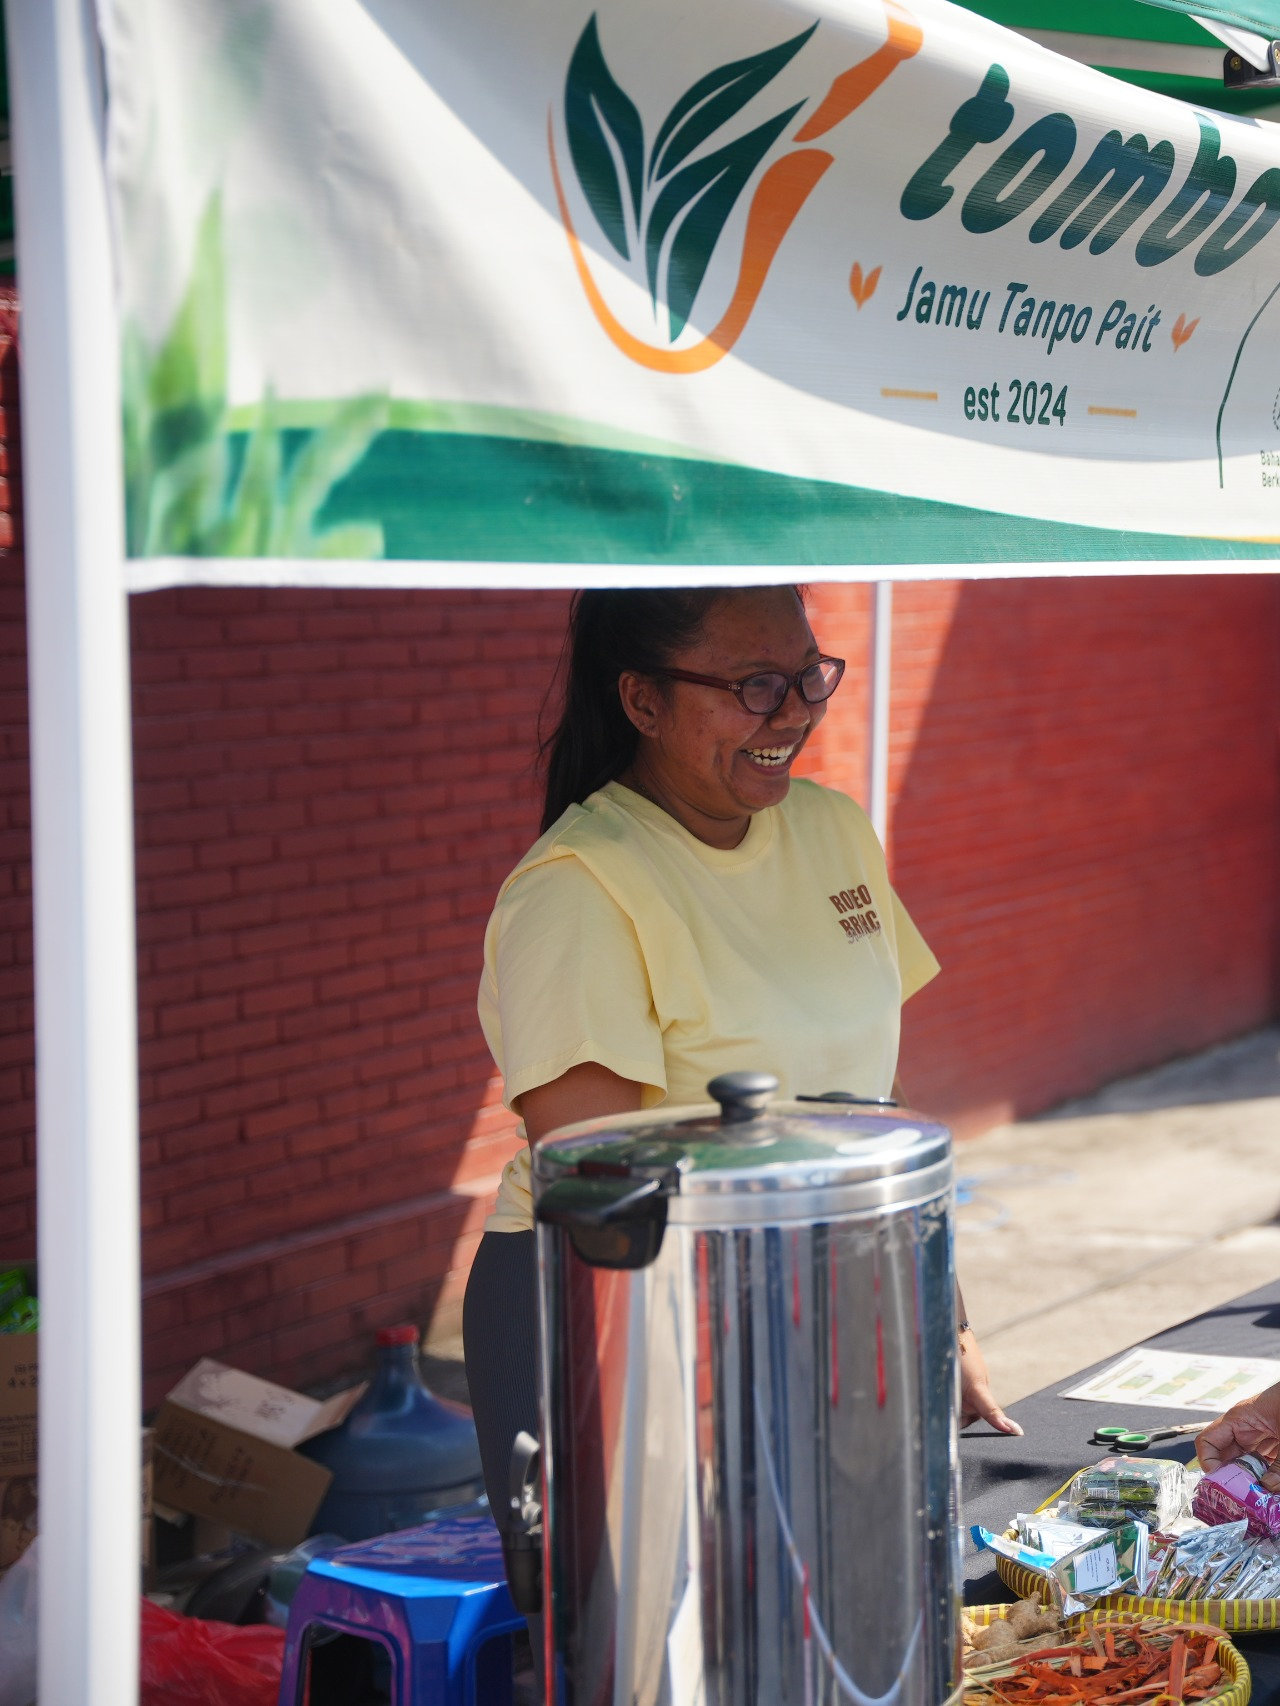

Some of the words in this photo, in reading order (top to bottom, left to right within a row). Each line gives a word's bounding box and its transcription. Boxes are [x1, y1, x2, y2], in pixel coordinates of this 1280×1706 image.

[896, 266, 991, 331] Jamu
[998, 281, 1093, 355] Tanpo
[1095, 300, 1162, 353] Pait
[963, 381, 1000, 422] est
[1007, 379, 1068, 427] 2024
